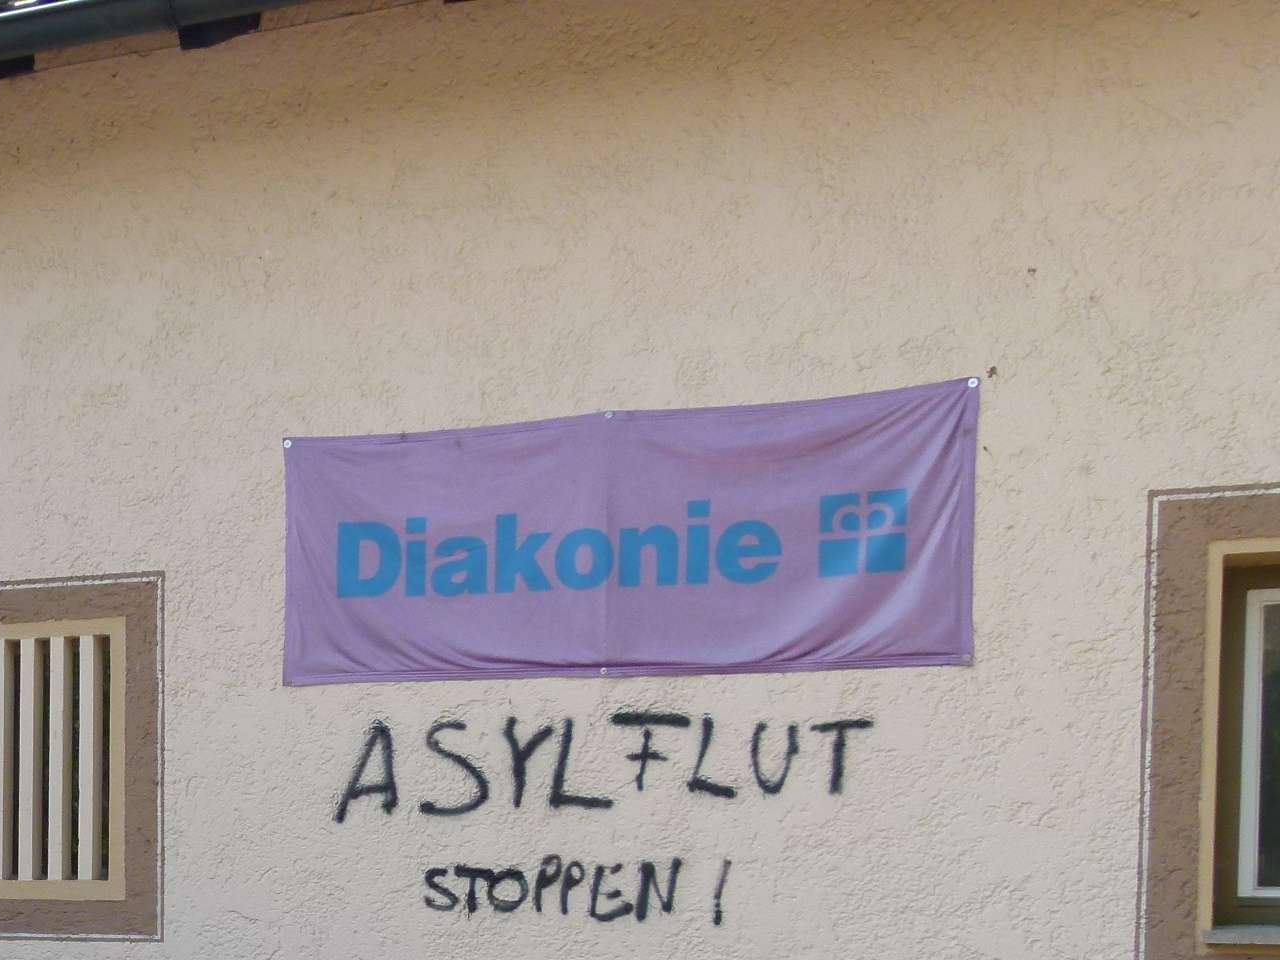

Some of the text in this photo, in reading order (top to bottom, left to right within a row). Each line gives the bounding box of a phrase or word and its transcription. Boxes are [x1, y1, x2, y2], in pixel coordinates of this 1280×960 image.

[336, 500, 783, 600] Diakonie
[332, 713, 874, 823] ASYLFLUT
[423, 855, 682, 923] STOPPEN
